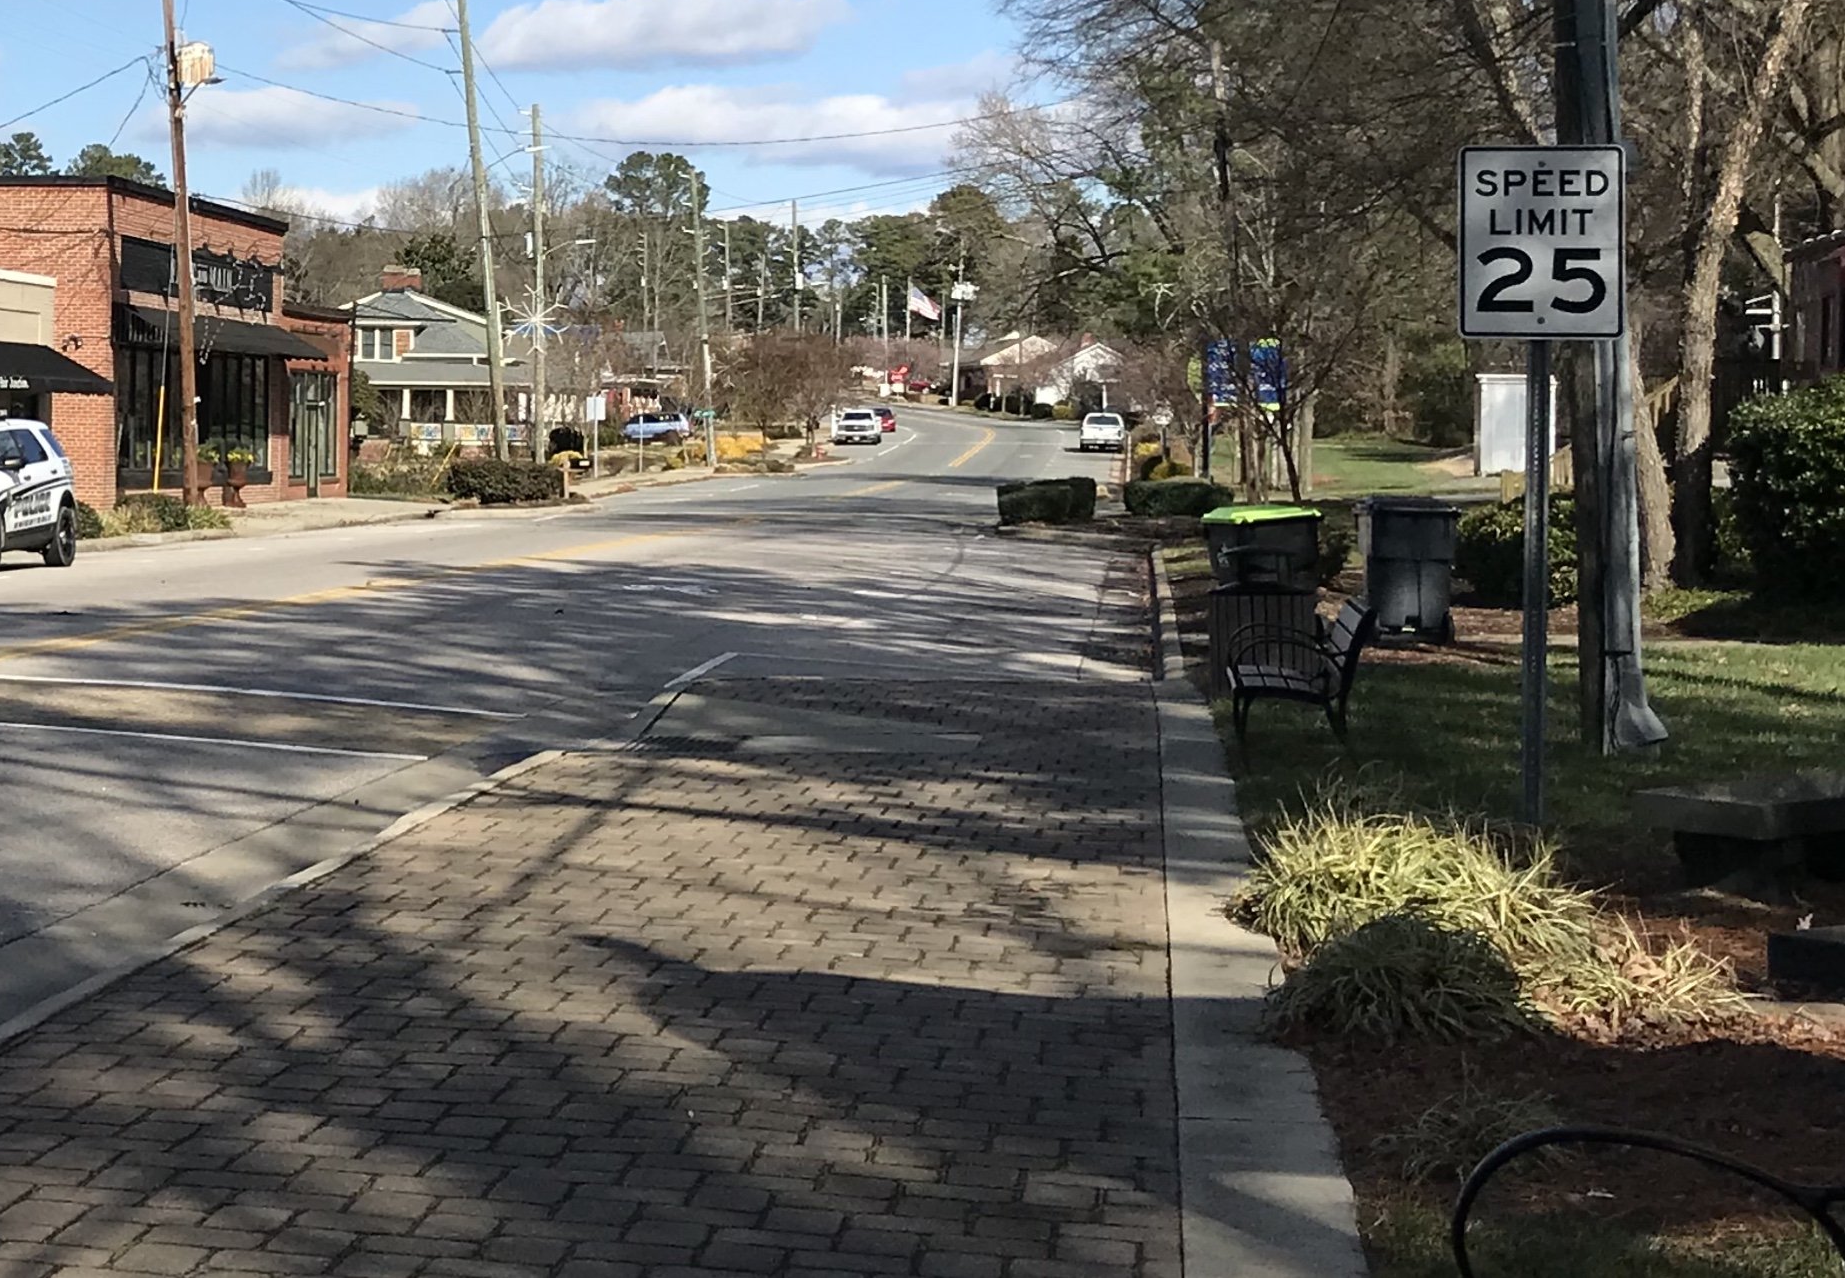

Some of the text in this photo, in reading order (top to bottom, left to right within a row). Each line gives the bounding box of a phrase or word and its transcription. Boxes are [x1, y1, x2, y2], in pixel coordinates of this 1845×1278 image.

[1475, 169, 1609, 197] SPEED
[1489, 208, 1594, 236] LIMIT
[1476, 246, 1607, 314] 25
[13, 491, 52, 519] POLICE
